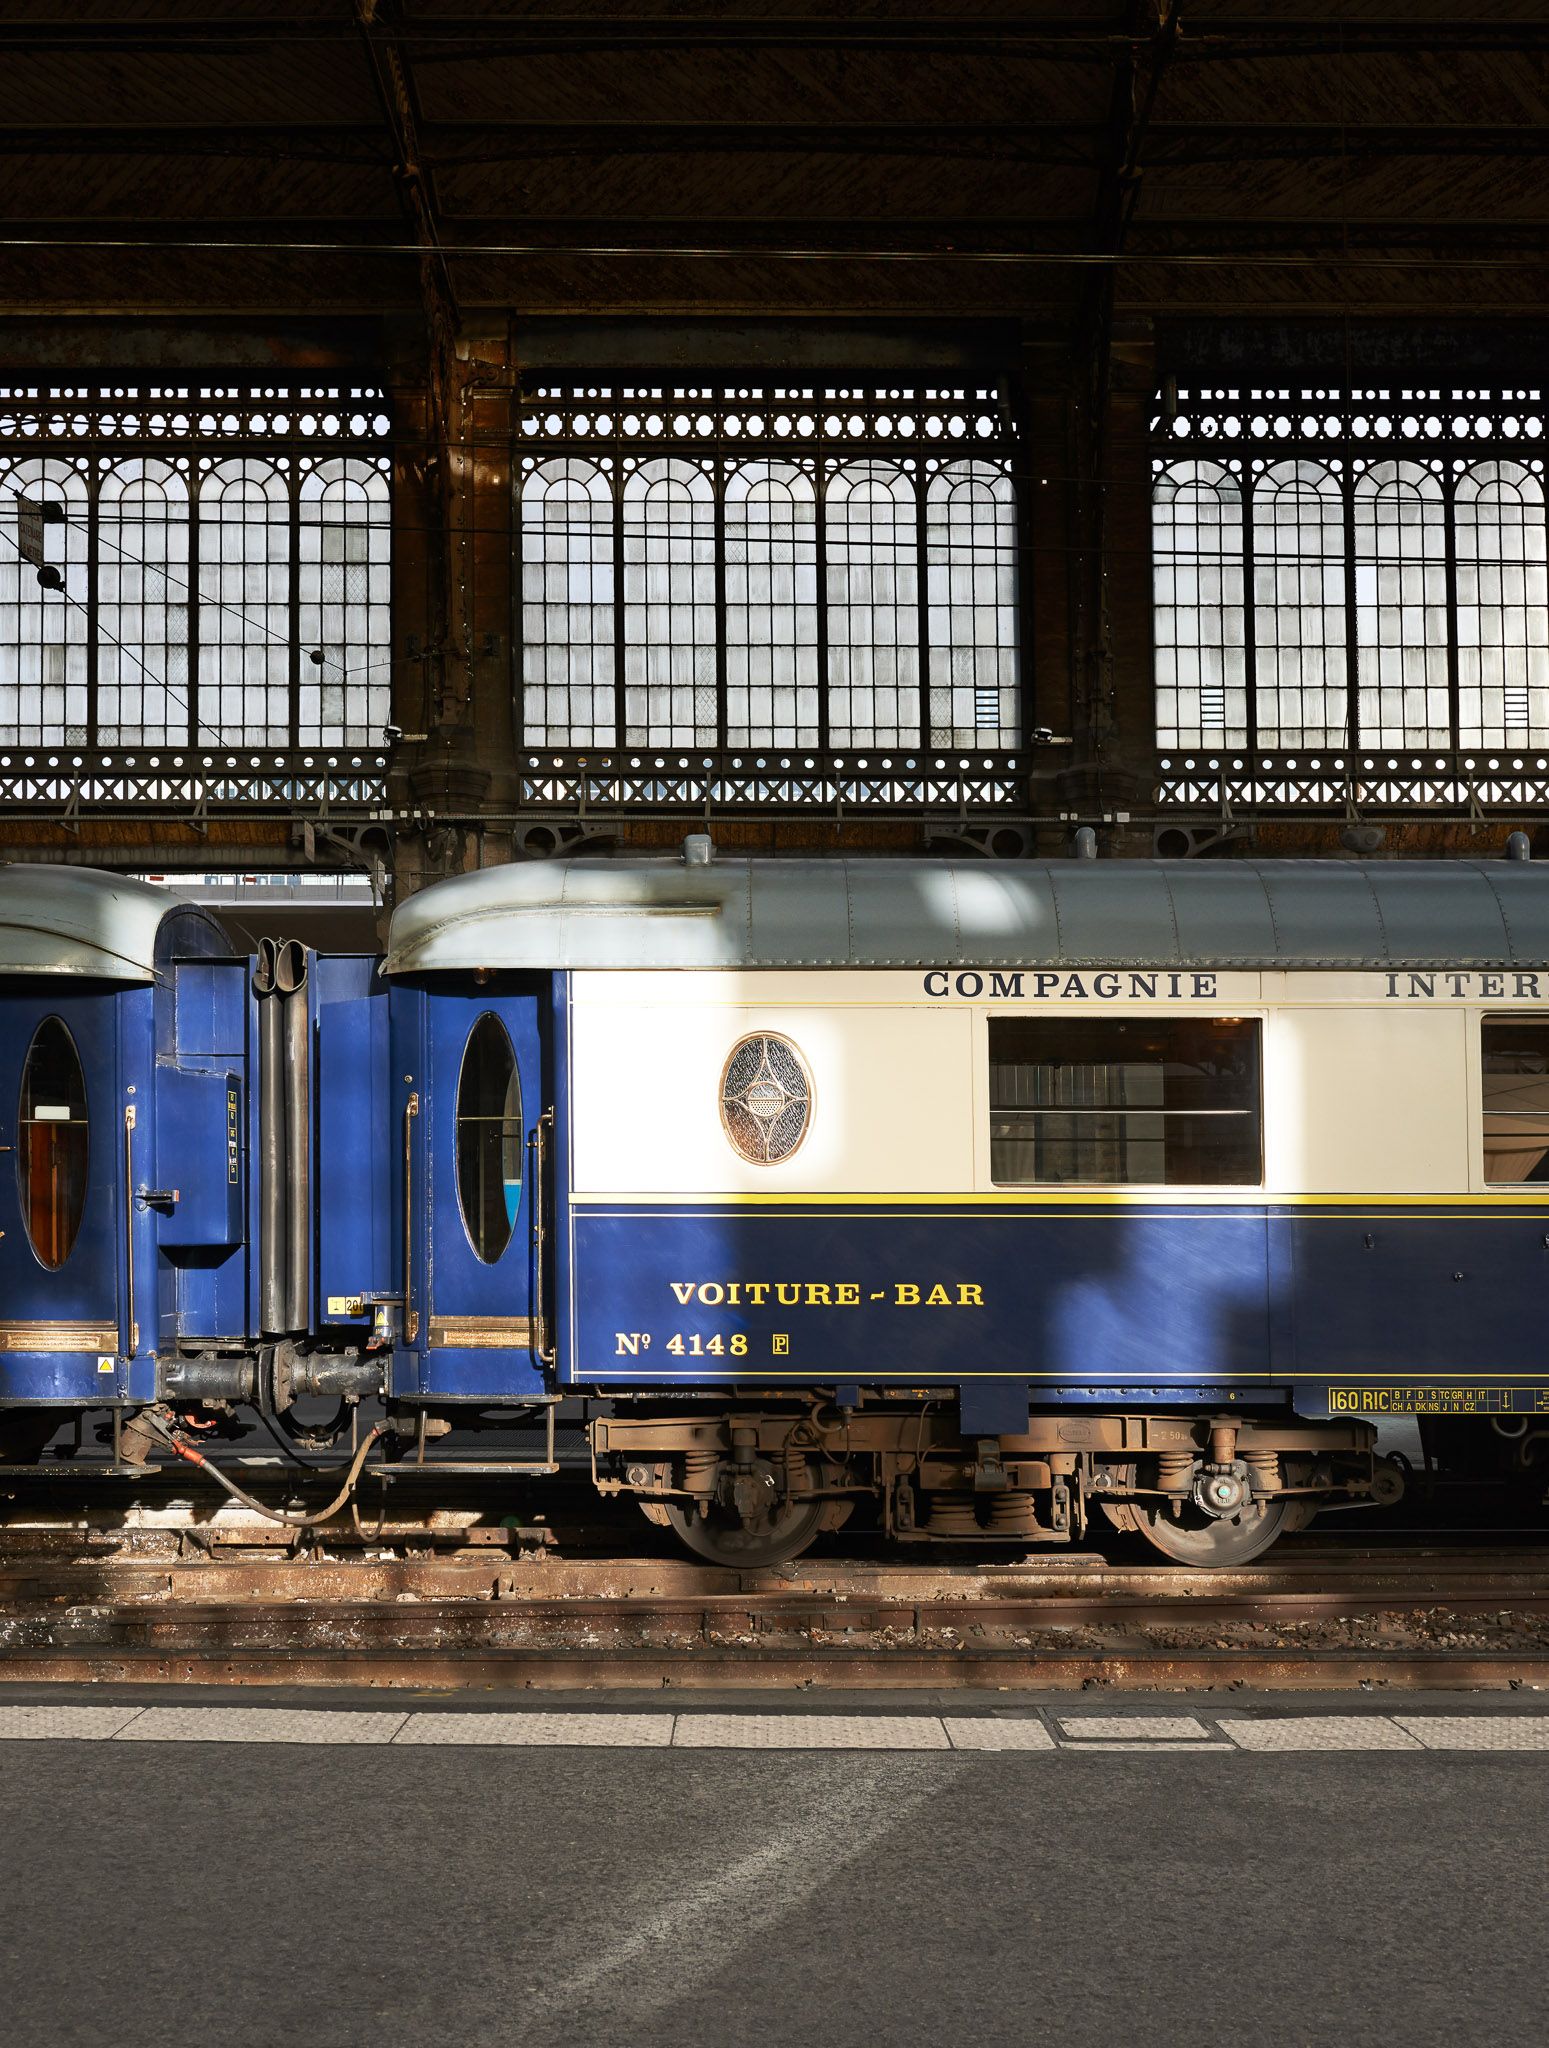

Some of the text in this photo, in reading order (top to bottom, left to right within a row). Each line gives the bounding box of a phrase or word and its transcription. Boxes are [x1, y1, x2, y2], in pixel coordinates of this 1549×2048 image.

[923, 971, 1549, 999] COMPAGNIE INTER
[670, 1282, 860, 1305] VOITURE
[894, 1284, 984, 1305] BAR
[665, 1333, 748, 1356] 4148
[774, 1335, 788, 1353] P
[1332, 1391, 1389, 1410] 160 RIC
[1394, 1390, 1486, 1400] B F D S TC GR H IT
[1392, 1402, 1403, 1411] CH
[1406, 1402, 1412, 1411] A
[1415, 1402, 1427, 1411] DK
[1442, 1402, 1448, 1411] J
[1454, 1402, 1459, 1411] N
[1464, 1402, 1475, 1411] CZ
